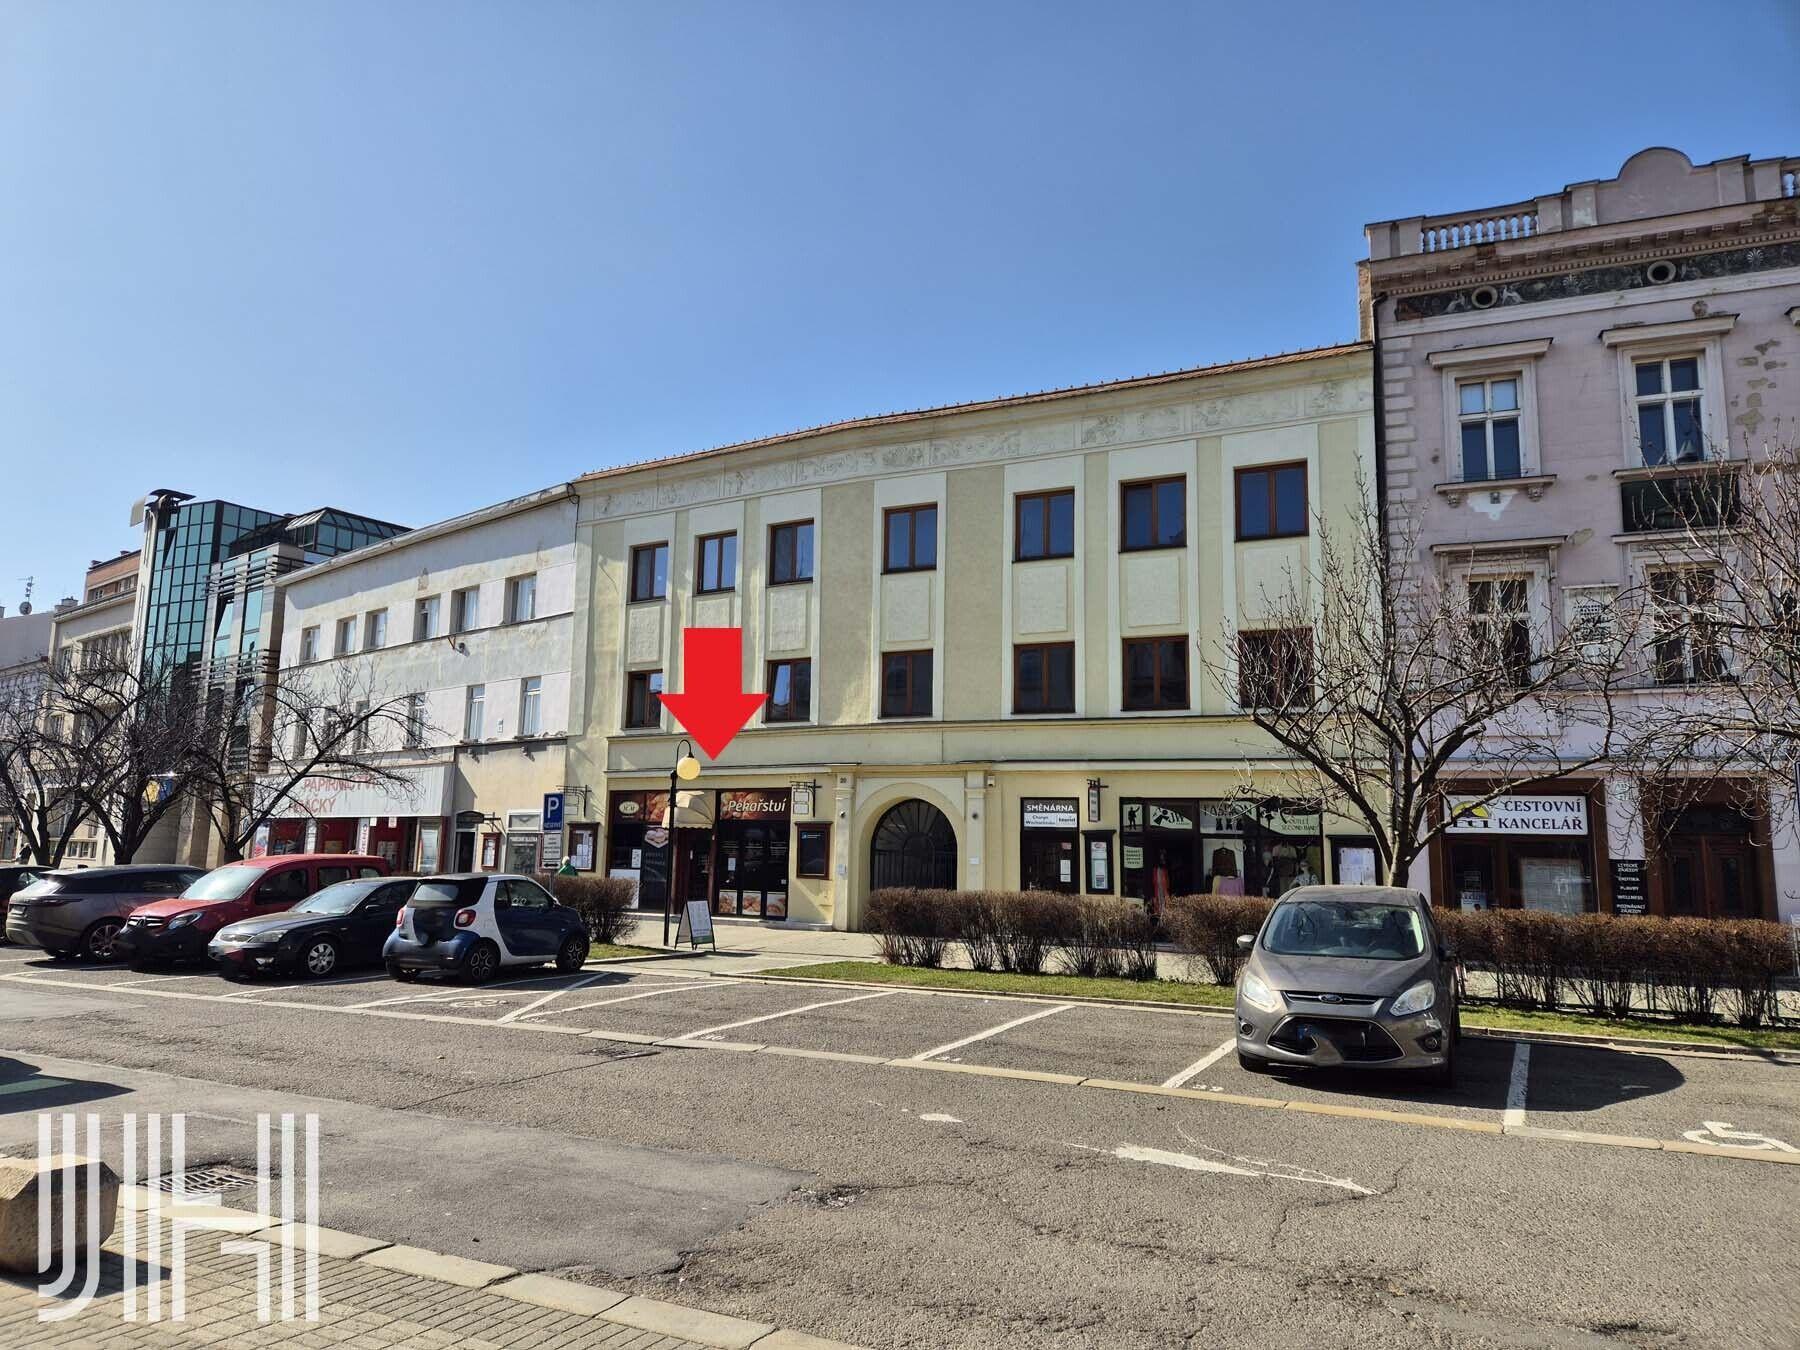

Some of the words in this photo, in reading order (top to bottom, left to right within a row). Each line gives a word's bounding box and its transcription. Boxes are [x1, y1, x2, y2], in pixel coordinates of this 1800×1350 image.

[546, 797, 559, 819] P
[1026, 803, 1074, 812] SMĚNÁRNA
[1504, 798, 1581, 813] CESTOVNÍ
[1498, 816, 1583, 830] KANCELÁŘ
